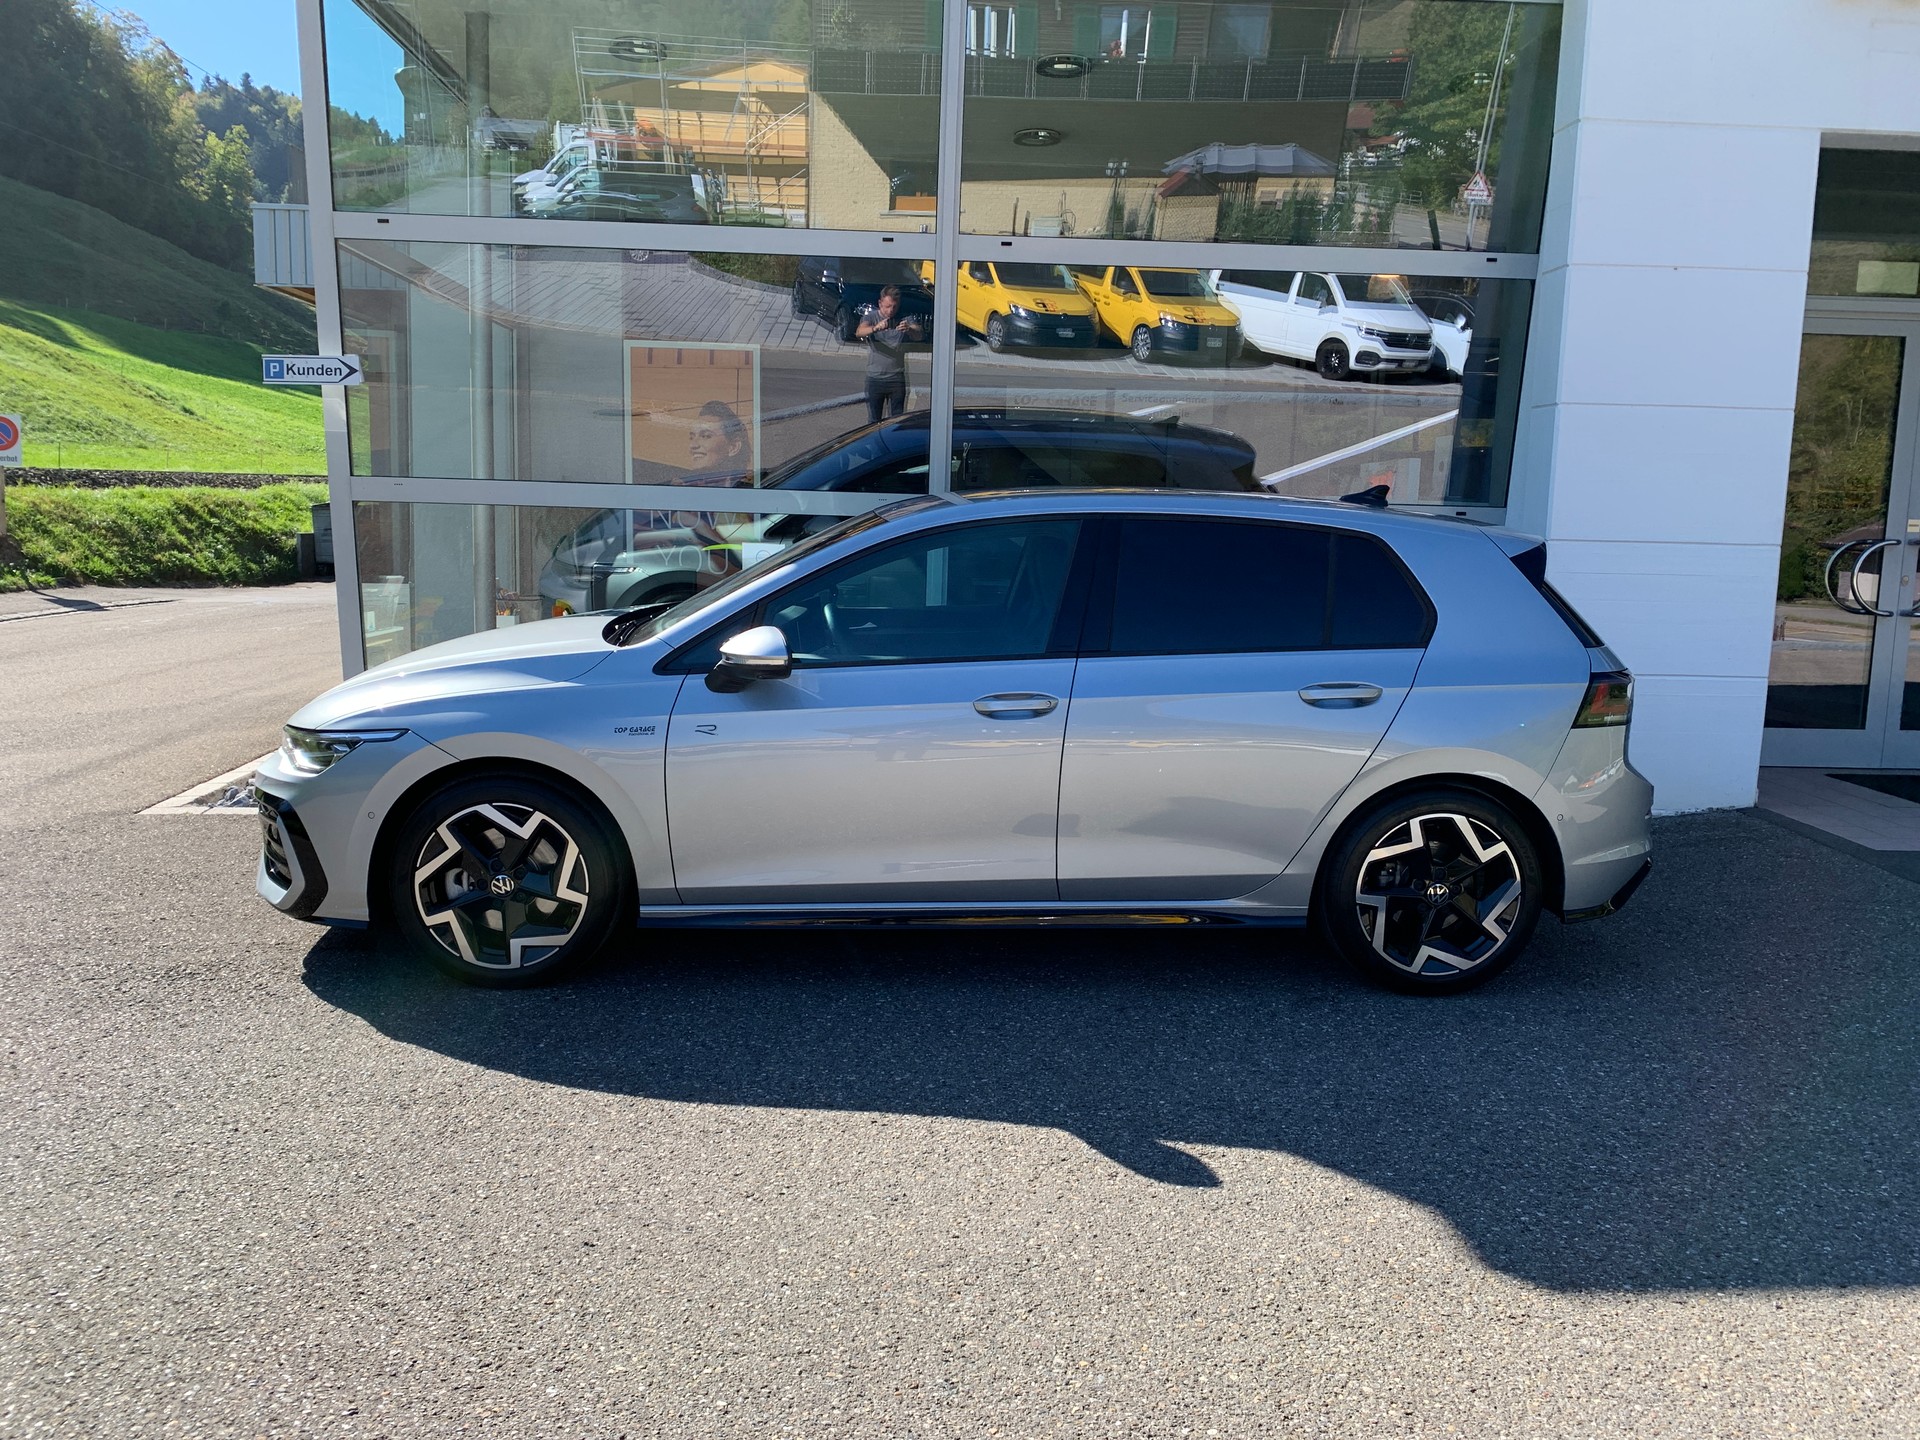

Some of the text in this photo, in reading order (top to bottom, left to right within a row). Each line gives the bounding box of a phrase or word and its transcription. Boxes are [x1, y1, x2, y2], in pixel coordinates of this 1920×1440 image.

[286, 363, 343, 377] Kunden
[650, 510, 737, 530] NOW
[656, 544, 729, 575] YOU
[629, 725, 656, 733] GARAGE
